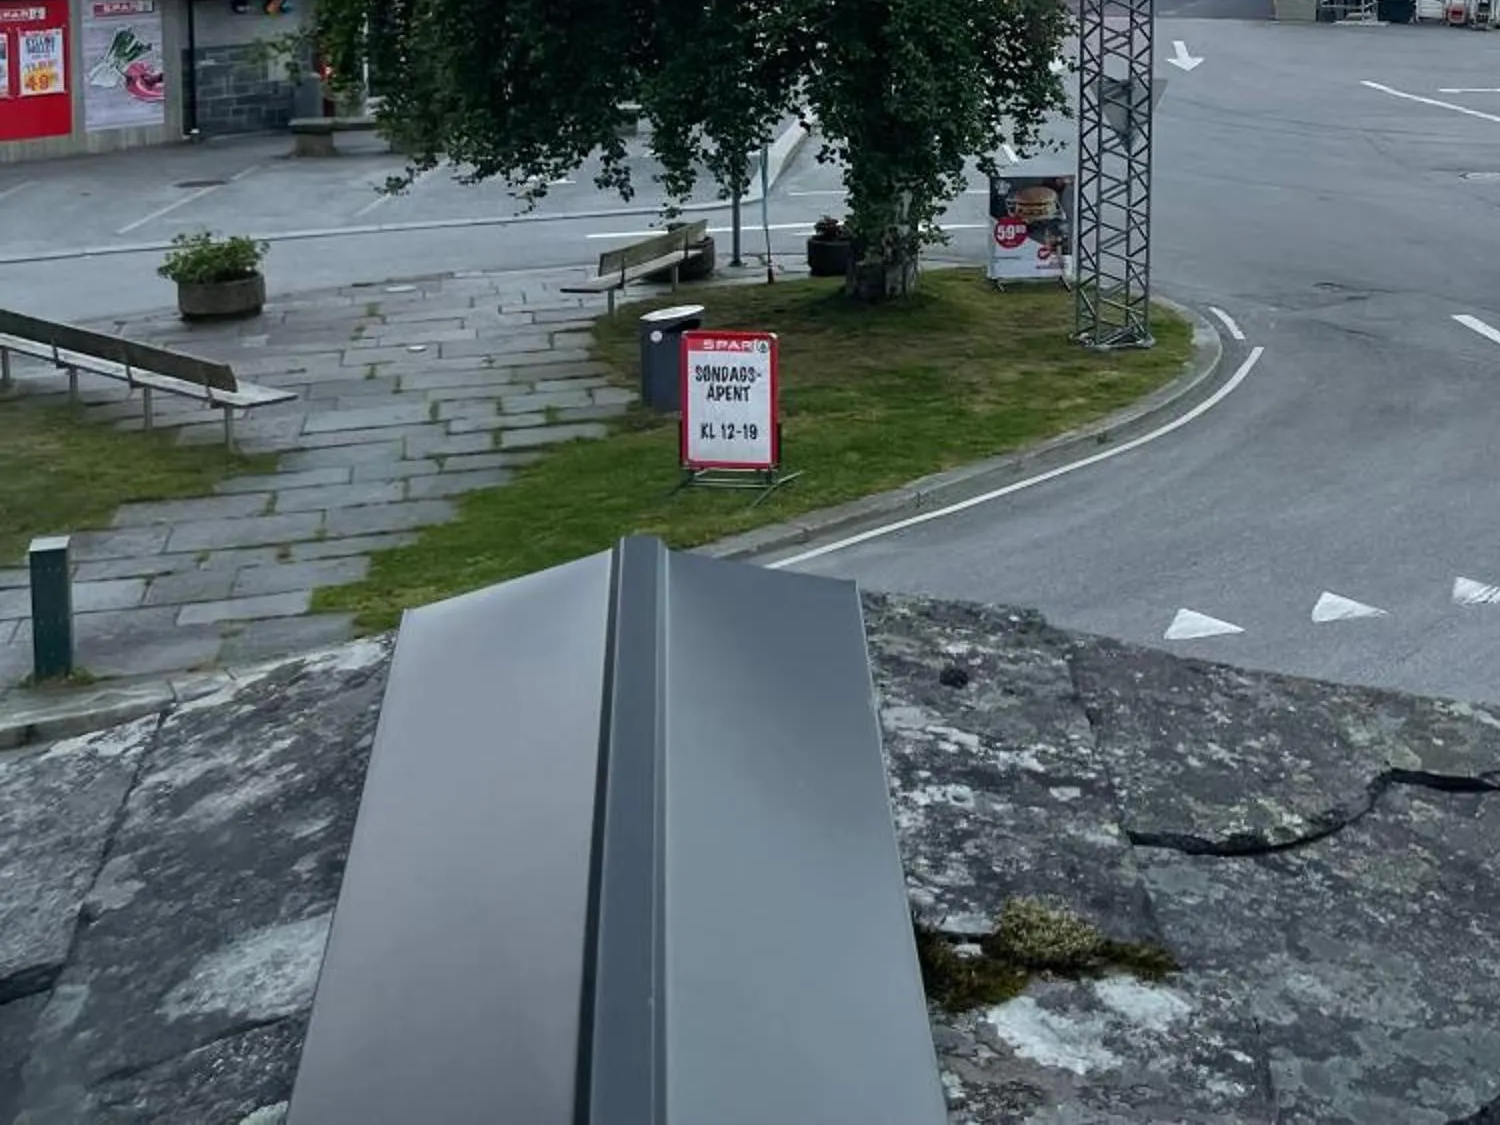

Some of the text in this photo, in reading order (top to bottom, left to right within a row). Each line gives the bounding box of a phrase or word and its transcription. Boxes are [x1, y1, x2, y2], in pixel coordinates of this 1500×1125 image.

[703, 339, 754, 352] SPAR
[701, 422, 758, 441] KL 12-19
